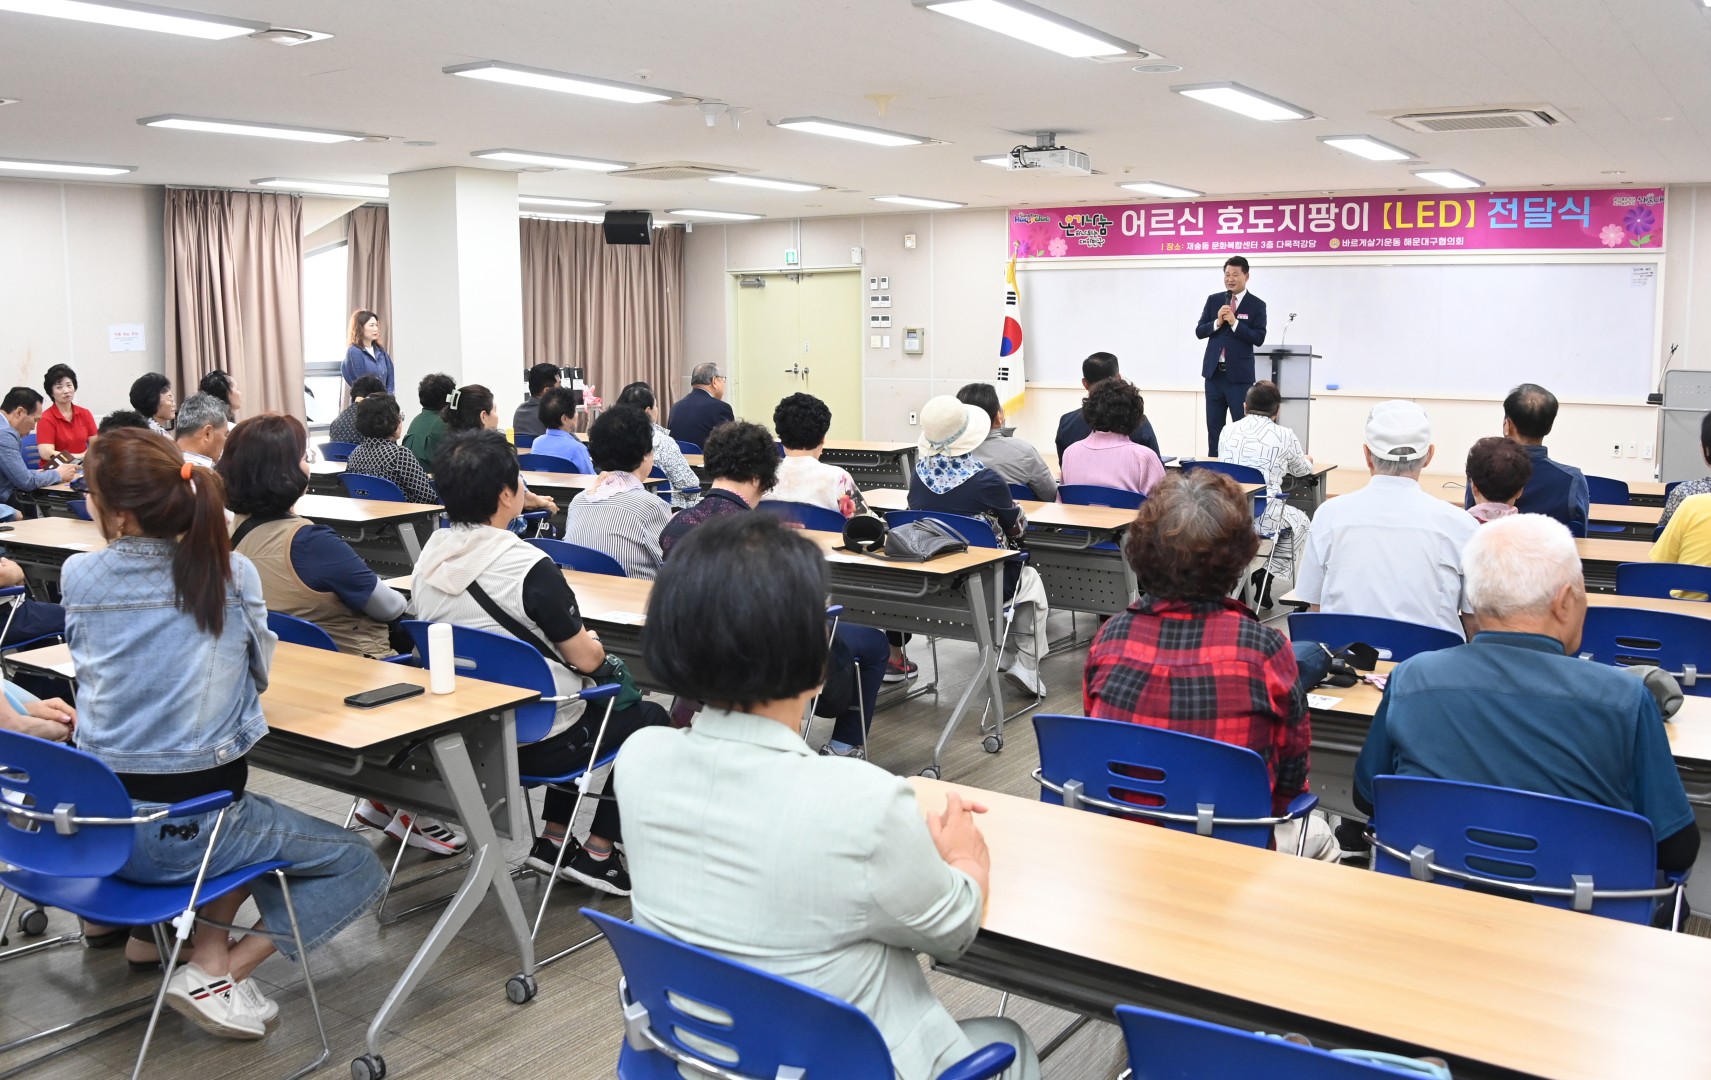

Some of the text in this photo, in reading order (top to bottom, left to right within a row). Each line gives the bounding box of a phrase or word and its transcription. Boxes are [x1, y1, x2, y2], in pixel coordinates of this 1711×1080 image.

[1121, 207, 1204, 237] 어르신
[1216, 201, 1369, 235] 효도지팡이
[1487, 196, 1590, 229] 전달식
[1166, 239, 1317, 251] 장소: 재송동 문화복합센터 3층 다목적강당
[1341, 236, 1465, 247] 바르게살기운동 해운대구협의회
